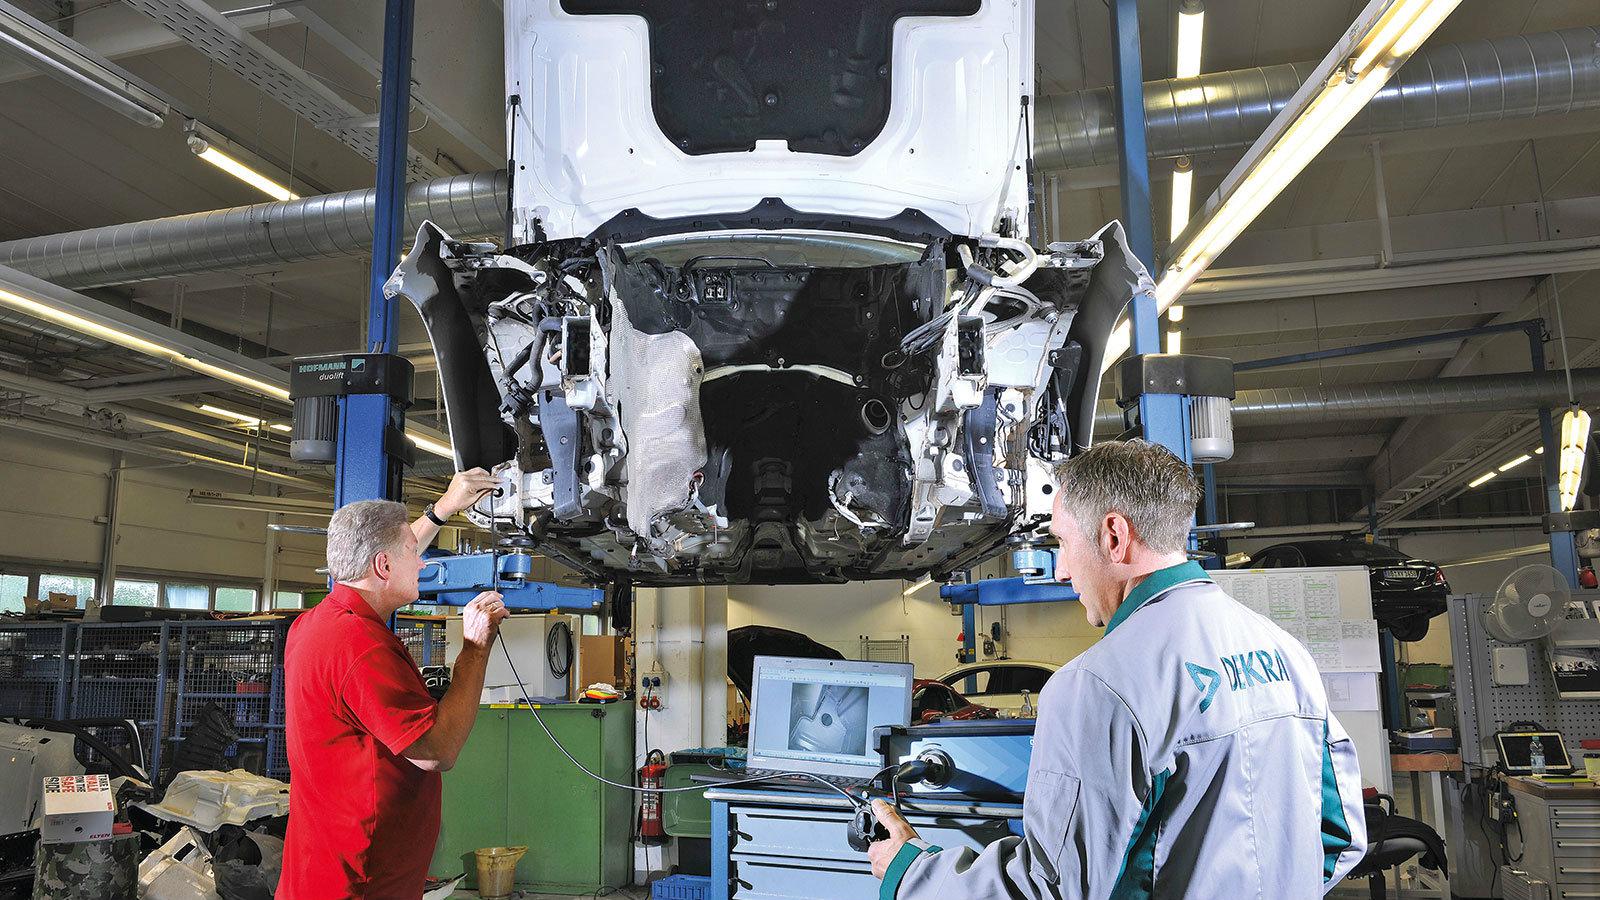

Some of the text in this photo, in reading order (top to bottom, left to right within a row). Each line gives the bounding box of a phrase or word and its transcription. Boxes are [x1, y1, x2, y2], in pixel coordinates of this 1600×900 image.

[299, 362, 347, 373] HOFMANN
[319, 372, 344, 381] duolift
[1220, 649, 1290, 691] DEKRA
[45, 777, 60, 793] SIDE
[61, 776, 75, 793] SAFE
[76, 783, 86, 792] THE
[86, 775, 99, 792] WALK
